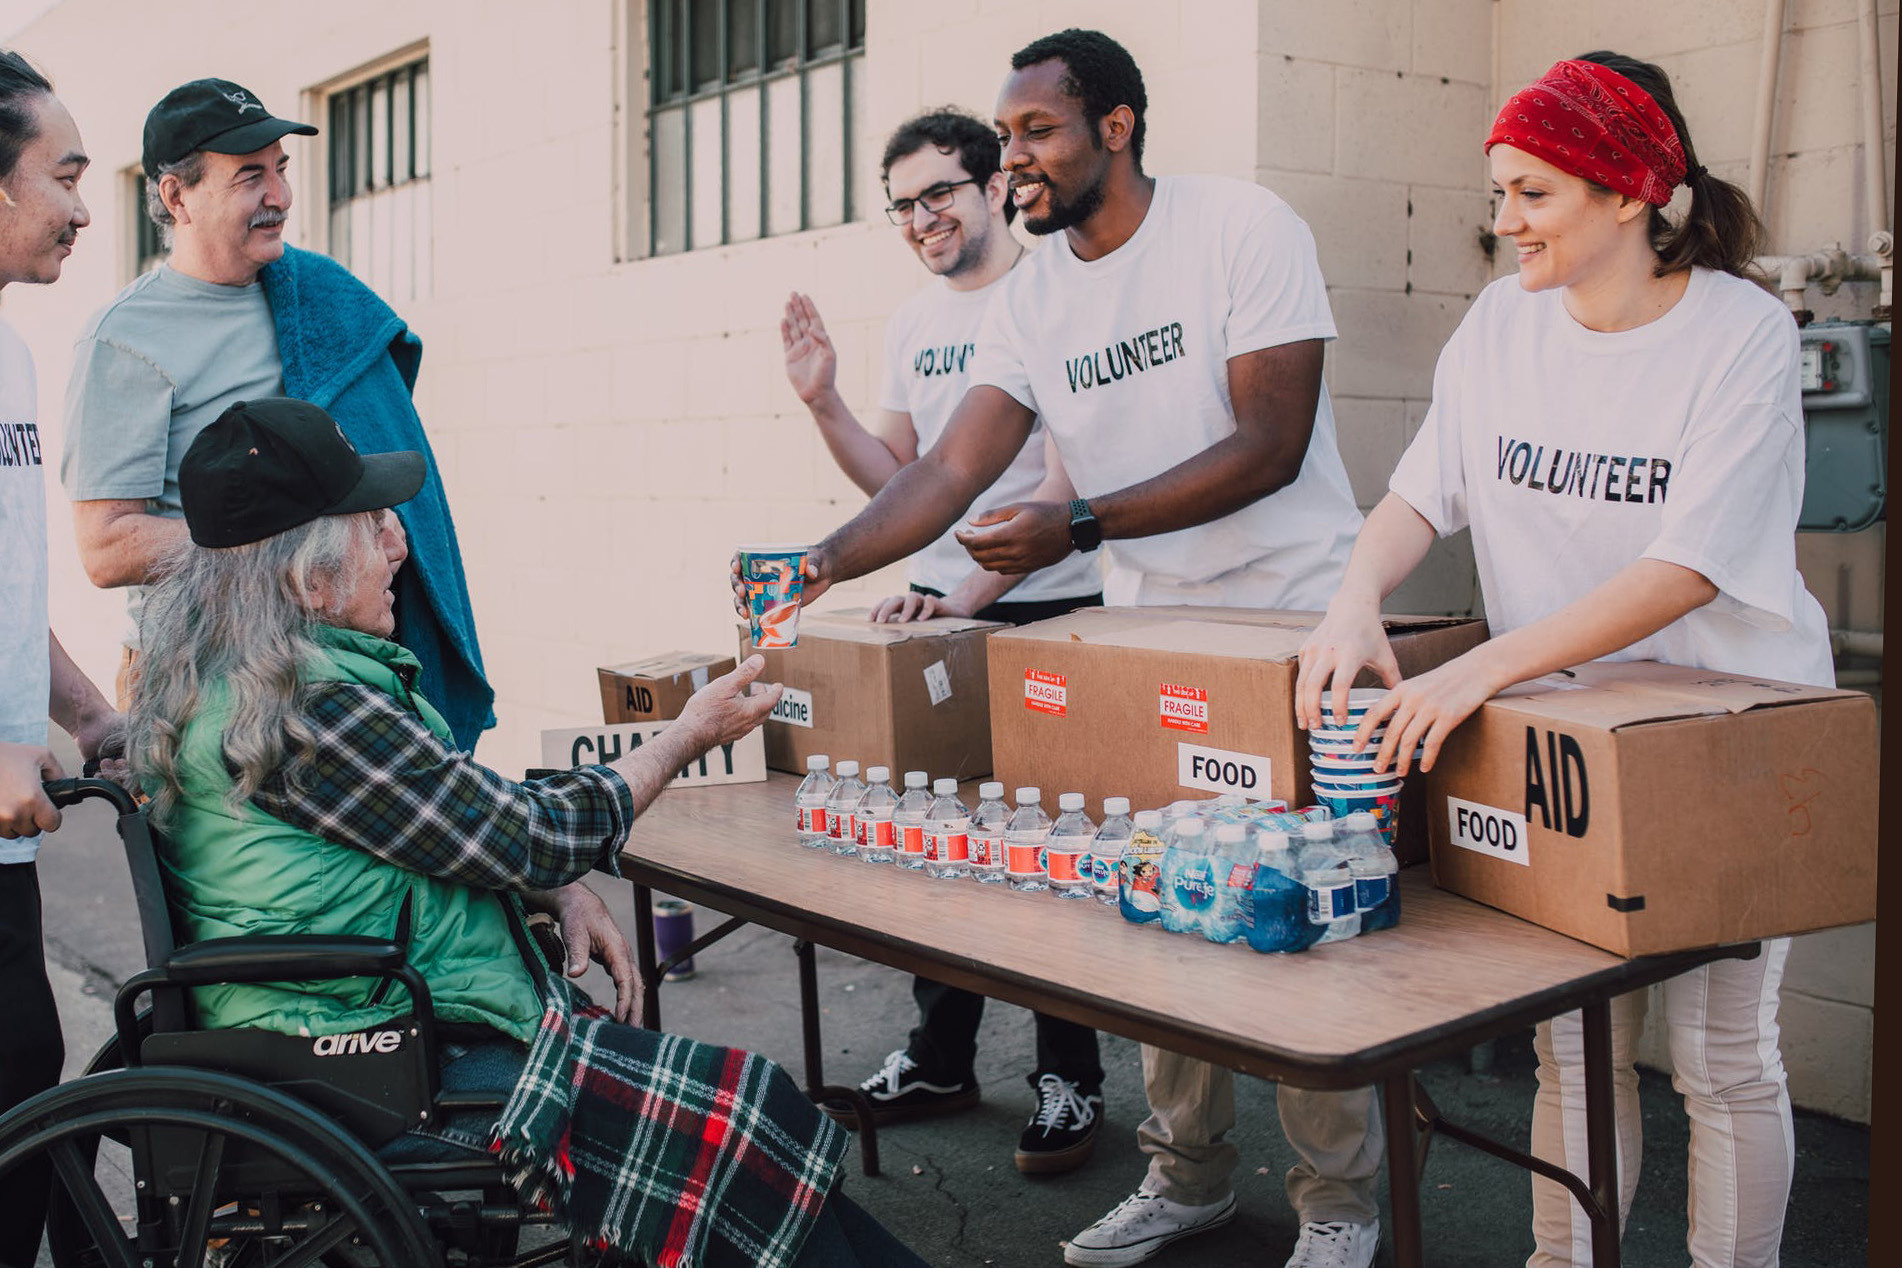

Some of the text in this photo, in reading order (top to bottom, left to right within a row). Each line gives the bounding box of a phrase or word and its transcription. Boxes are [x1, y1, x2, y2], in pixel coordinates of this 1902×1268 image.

[1065, 321, 1186, 393] VOLUNTEER
[1497, 435, 1672, 504] VOLUNTEER
[626, 685, 653, 713] AID
[1028, 684, 1063, 702] FRAGILE
[1164, 700, 1204, 718] FRAGILE
[1192, 755, 1257, 789] FOOD
[1525, 726, 1589, 838] AID
[1457, 807, 1517, 851] FOOD
